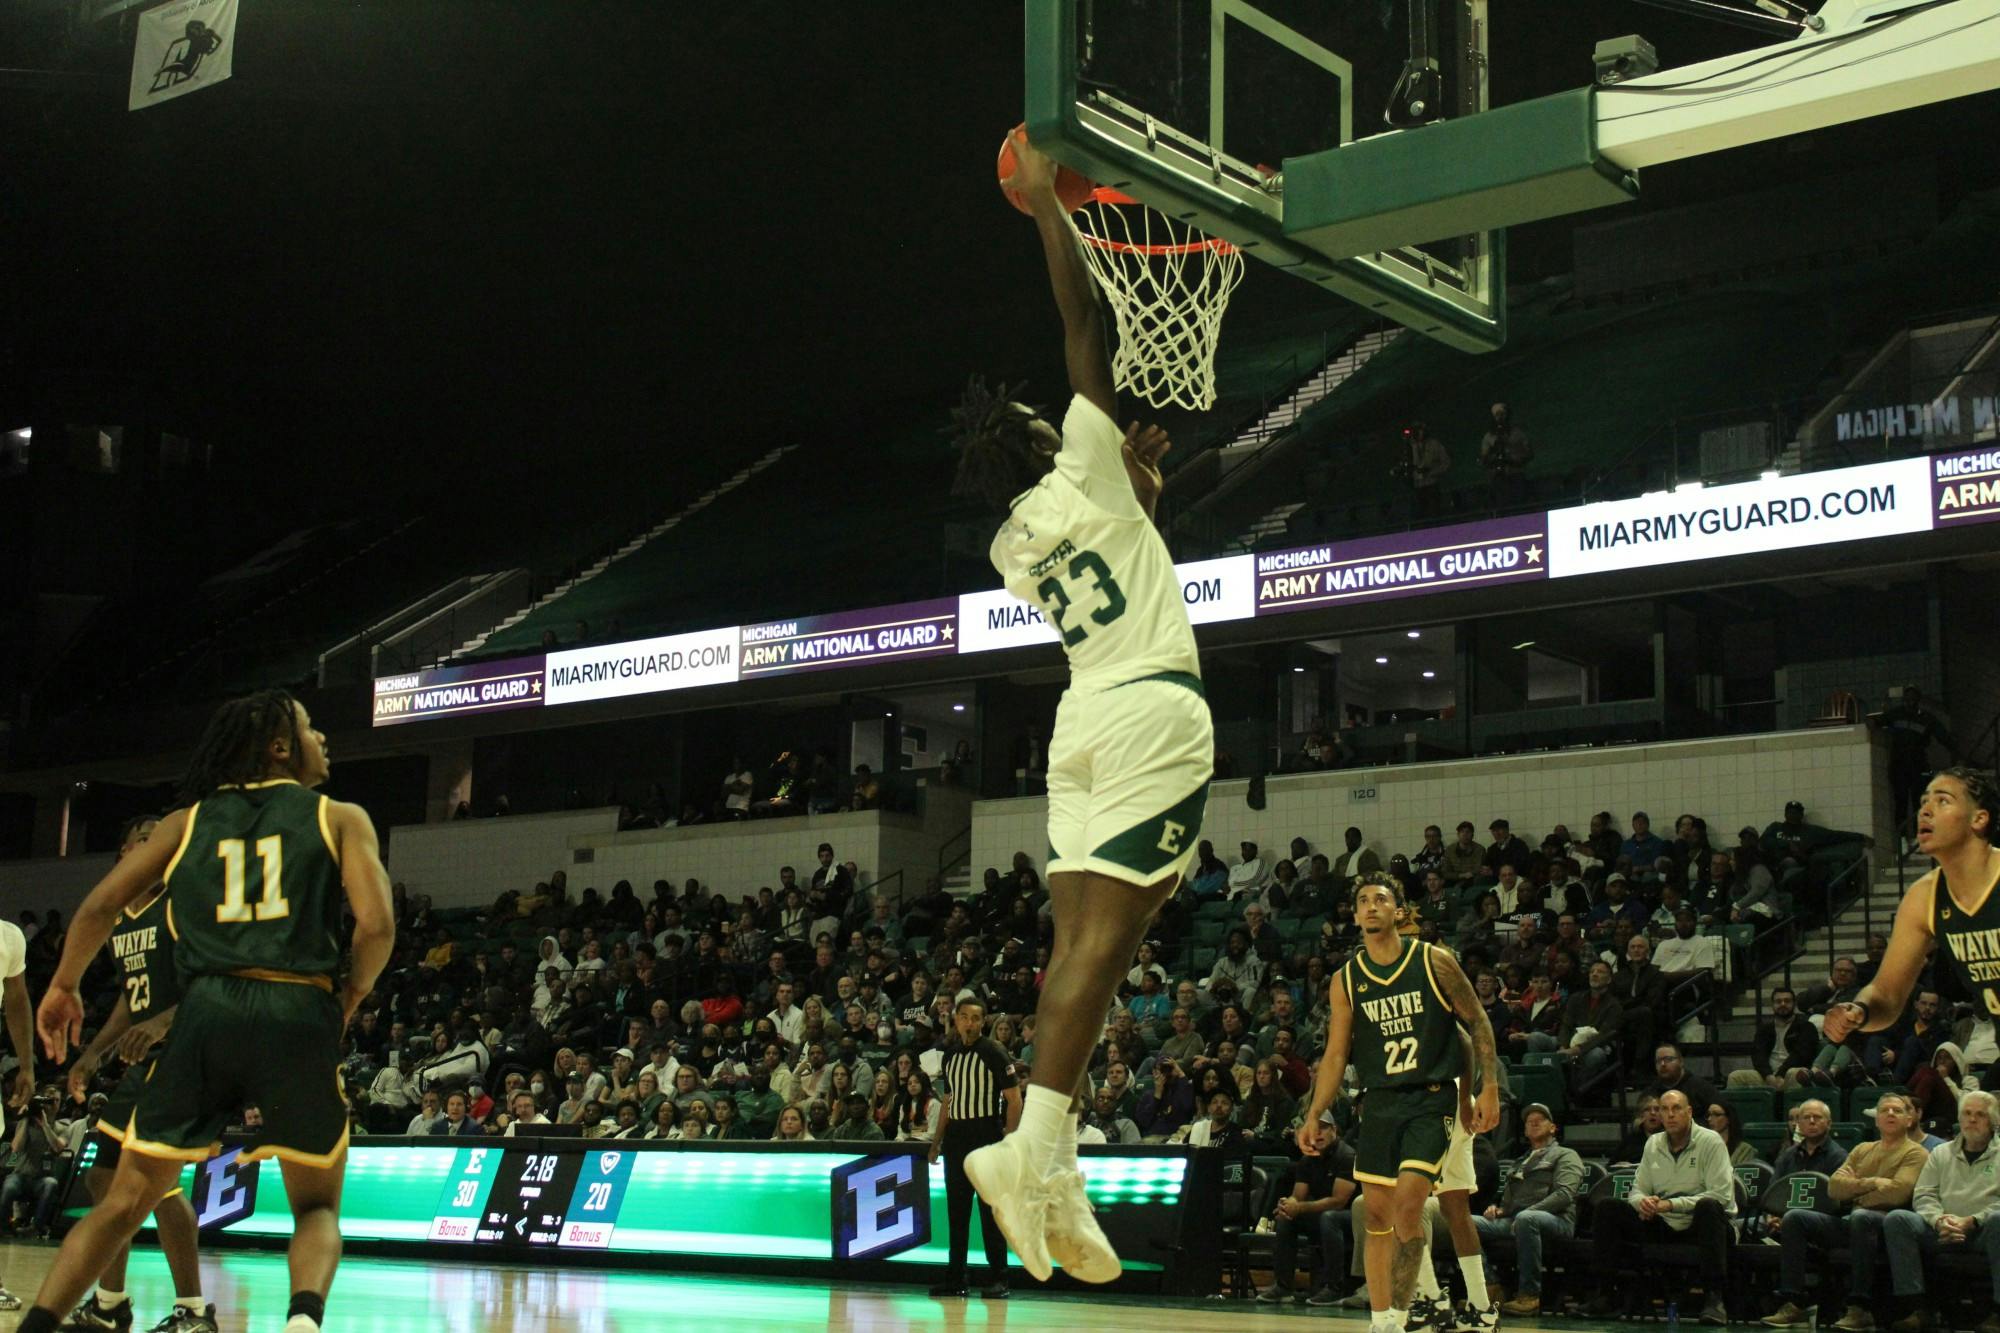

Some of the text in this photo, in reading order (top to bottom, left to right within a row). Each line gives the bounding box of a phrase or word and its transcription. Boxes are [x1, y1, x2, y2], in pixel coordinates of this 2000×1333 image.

[1578, 484, 1897, 552] MIARMYGUARD.COM
[1258, 547, 1332, 572] MICHIGAN
[1259, 546, 1519, 600] ARMY NATIONAL GUARD
[1037, 549, 1127, 649] 23
[742, 622, 798, 642] MICHIGAN
[987, 604, 1047, 631] MIAR
[742, 624, 938, 667] ARMY NATIONAL GUARD
[551, 644, 731, 688] MIARMYGUARD.COM
[374, 679, 529, 716] ARMY NATIONAL GUARD
[375, 675, 419, 692] MICHIGAN
[1353, 788, 1376, 800] 120
[1156, 819, 1186, 856] E
[215, 833, 290, 924] 11
[112, 925, 158, 960] WAYNE
[1944, 927, 2000, 962] WAYN
[123, 951, 148, 973] STATE
[126, 973, 151, 1014] 23
[1360, 990, 1425, 1024] WAYNE
[1379, 1016, 1414, 1037] STATE
[1383, 1035, 1420, 1076] 22
[463, 1148, 488, 1174] E
[519, 1154, 559, 1183] 2:18
[197, 1146, 251, 1228] E
[451, 1180, 480, 1208] 30
[582, 1182, 614, 1211] 20
[1612, 1174, 1635, 1200] E
[1735, 1167, 1760, 1198] E
[1786, 1177, 1817, 1209] E
[523, 1200, 529, 1210] 1
[847, 1155, 914, 1257] E
[437, 1219, 468, 1236] Bonus
[569, 1225, 602, 1243] Bonus
